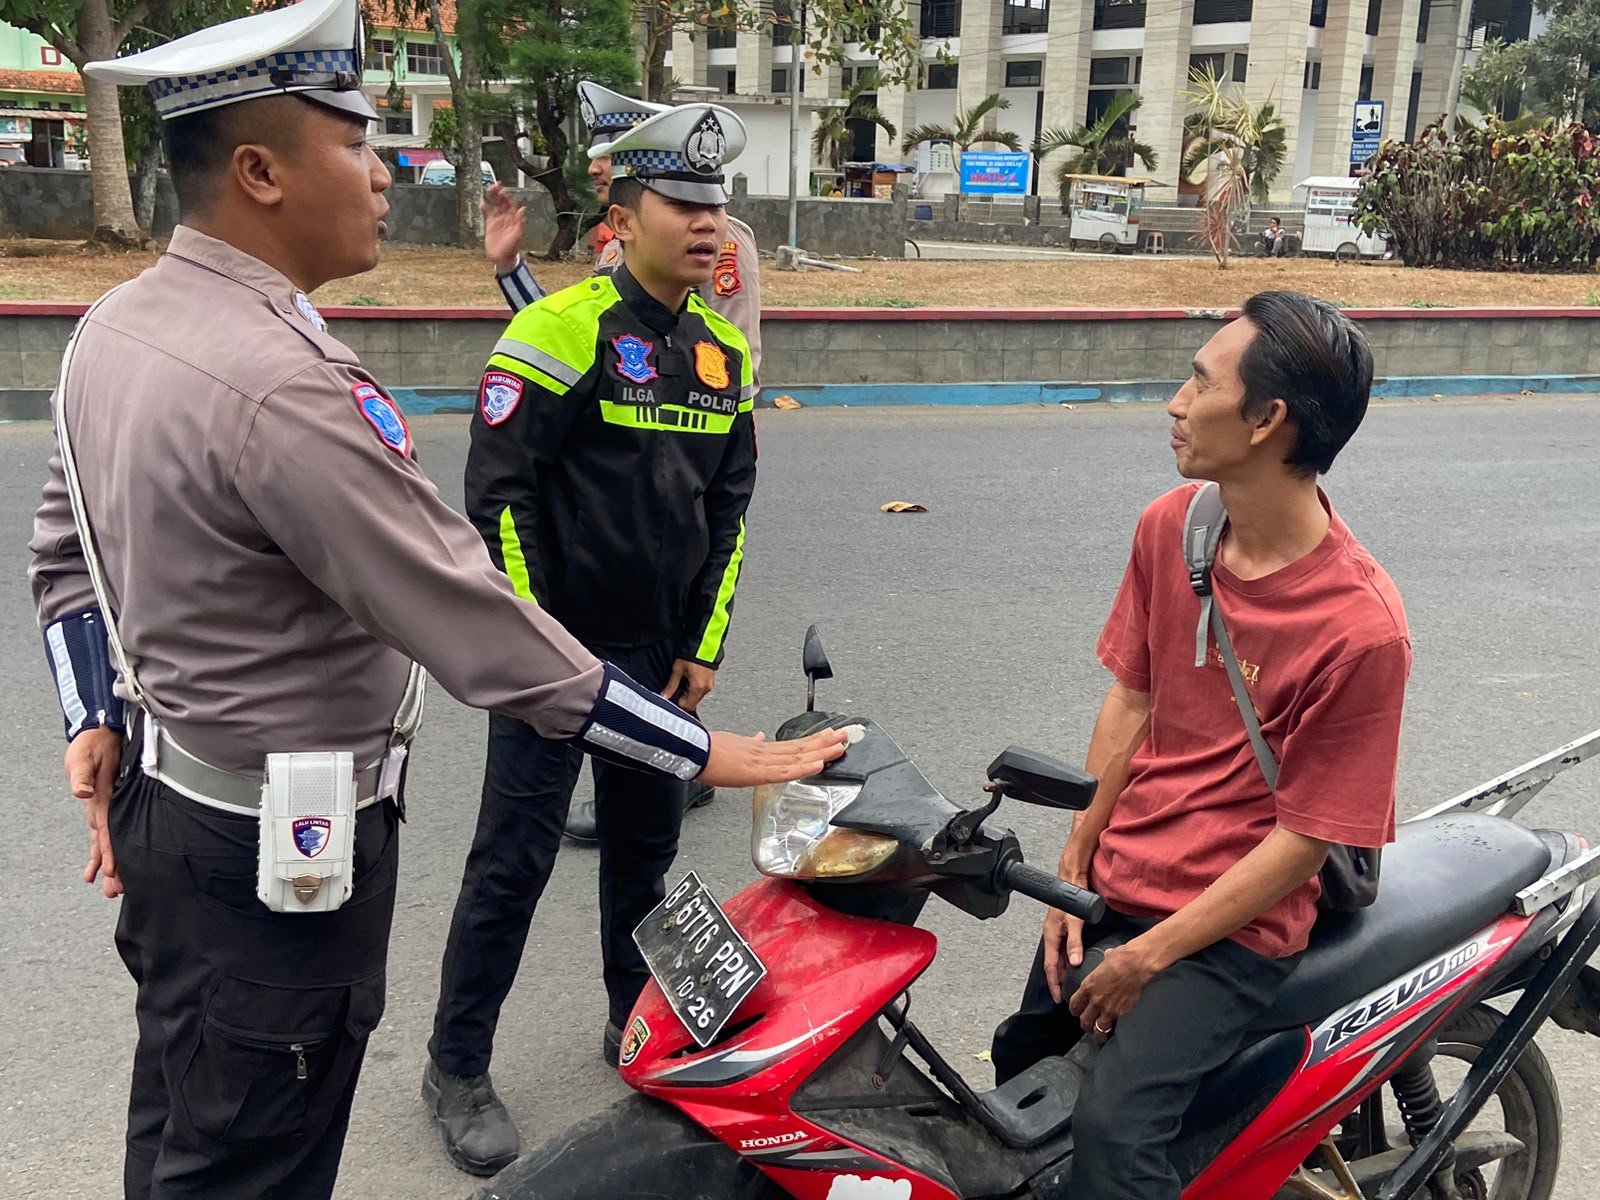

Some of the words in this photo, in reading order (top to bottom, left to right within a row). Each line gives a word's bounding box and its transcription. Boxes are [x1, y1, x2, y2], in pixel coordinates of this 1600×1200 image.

[622, 387, 655, 403] ILGA
[687, 391, 736, 413] POLRI
[294, 820, 309, 828] LALU
[665, 881, 690, 910] B
[676, 897, 720, 955] 6776
[705, 940, 755, 999] PPN
[1325, 957, 1447, 1051] REVO
[1448, 942, 1478, 974] 110
[740, 1130, 808, 1148] HONDA
